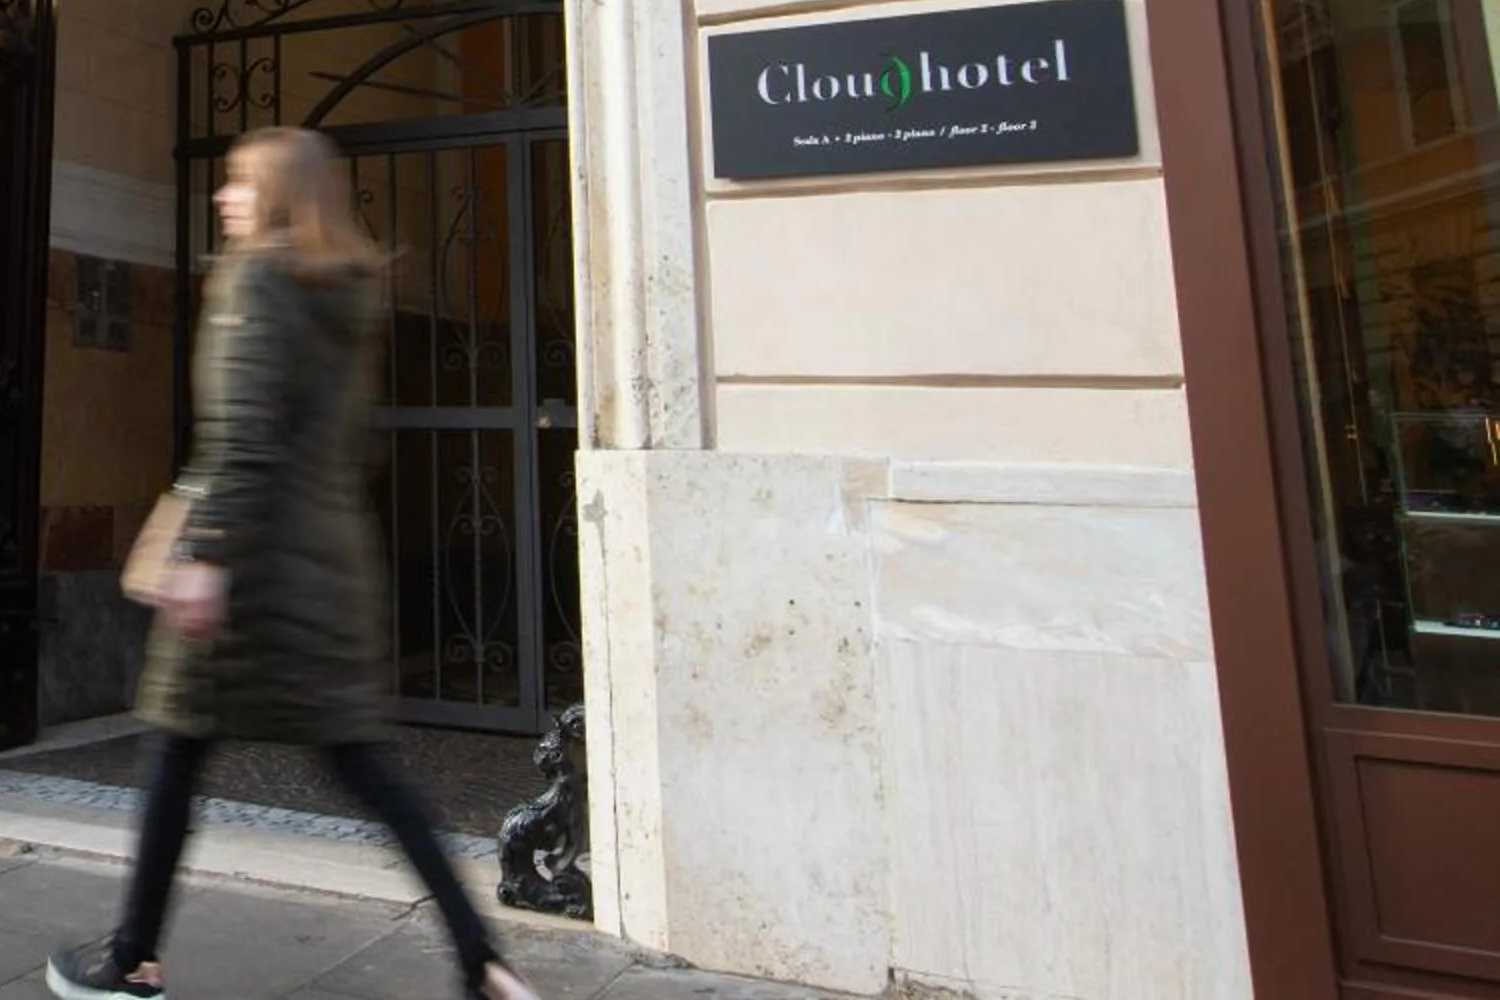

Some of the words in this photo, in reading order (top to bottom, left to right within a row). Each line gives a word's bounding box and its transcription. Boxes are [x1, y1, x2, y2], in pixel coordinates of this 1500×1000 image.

[793, 135, 819, 147] Scala
[852, 131, 885, 145] piano
[902, 128, 935, 141] piano
[948, 124, 979, 139] floor
[996, 121, 1027, 135] floor
